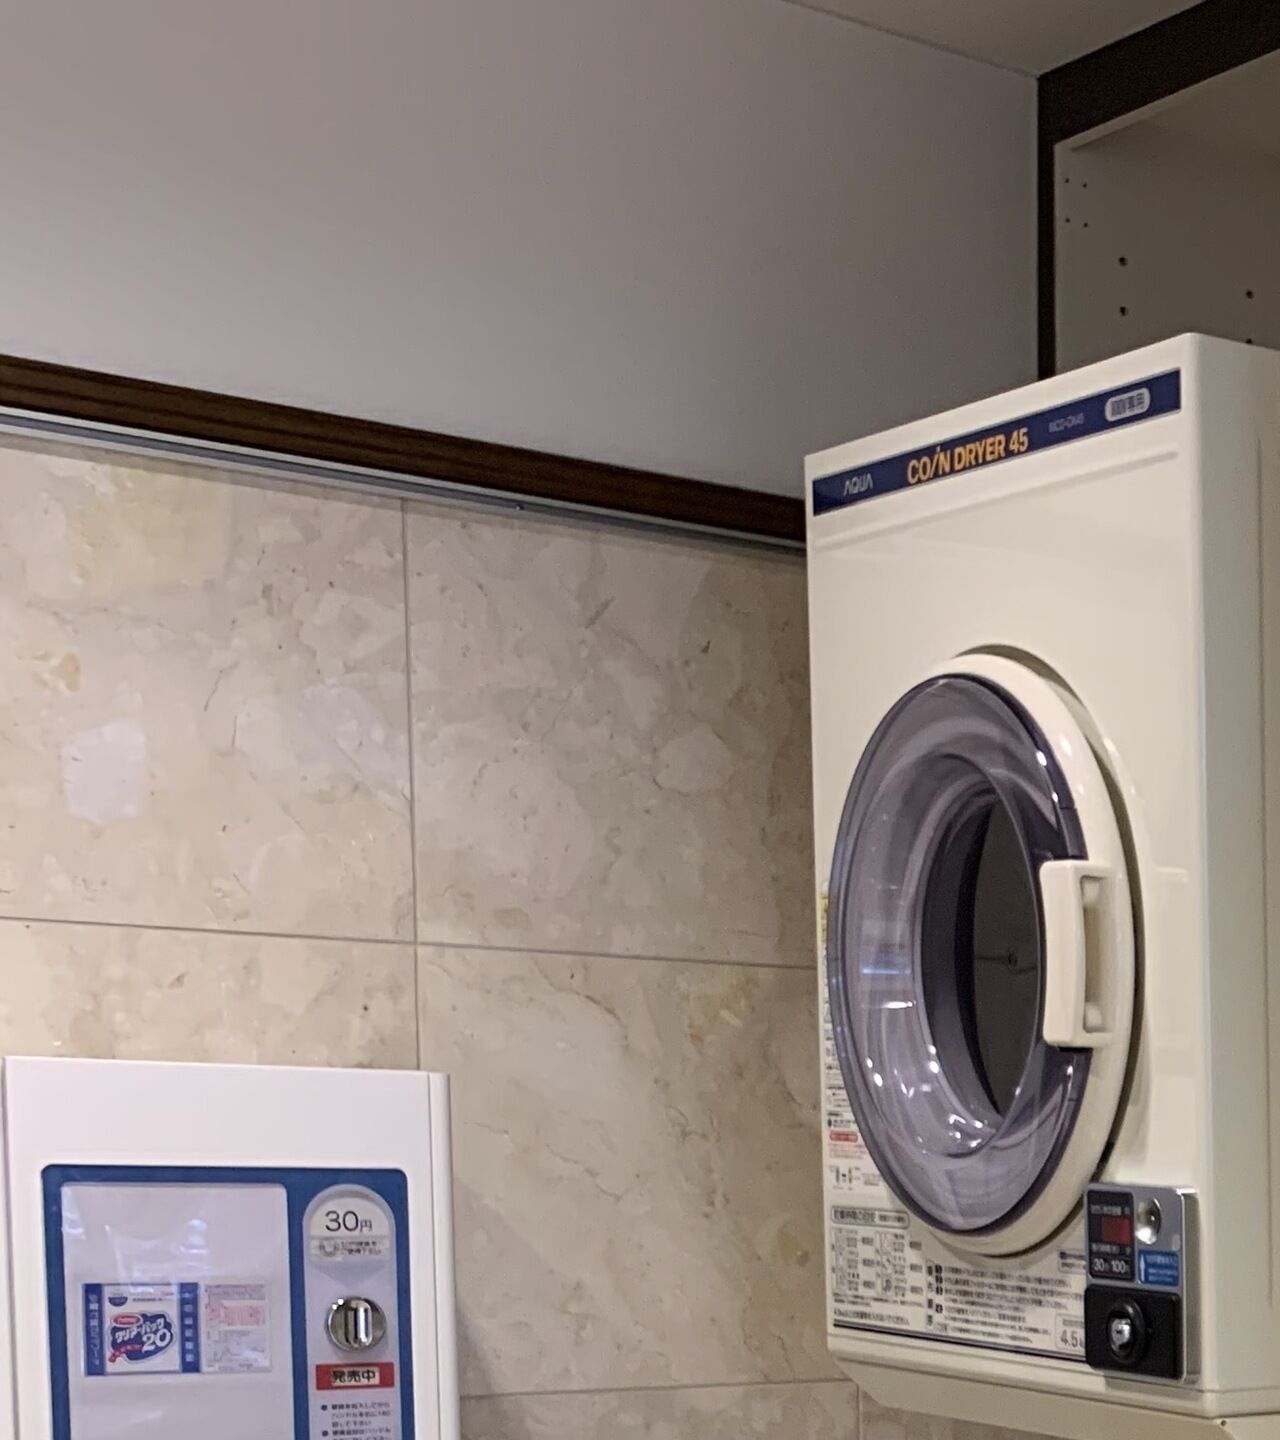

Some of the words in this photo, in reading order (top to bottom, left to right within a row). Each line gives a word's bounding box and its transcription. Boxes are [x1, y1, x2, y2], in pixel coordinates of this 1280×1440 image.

[843, 472, 873, 497] AQUA
[953, 433, 1007, 472] DRYER
[1009, 426, 1029, 453] 45
[325, 1210, 373, 1232] 30円
[142, 1328, 171, 1354] 20
